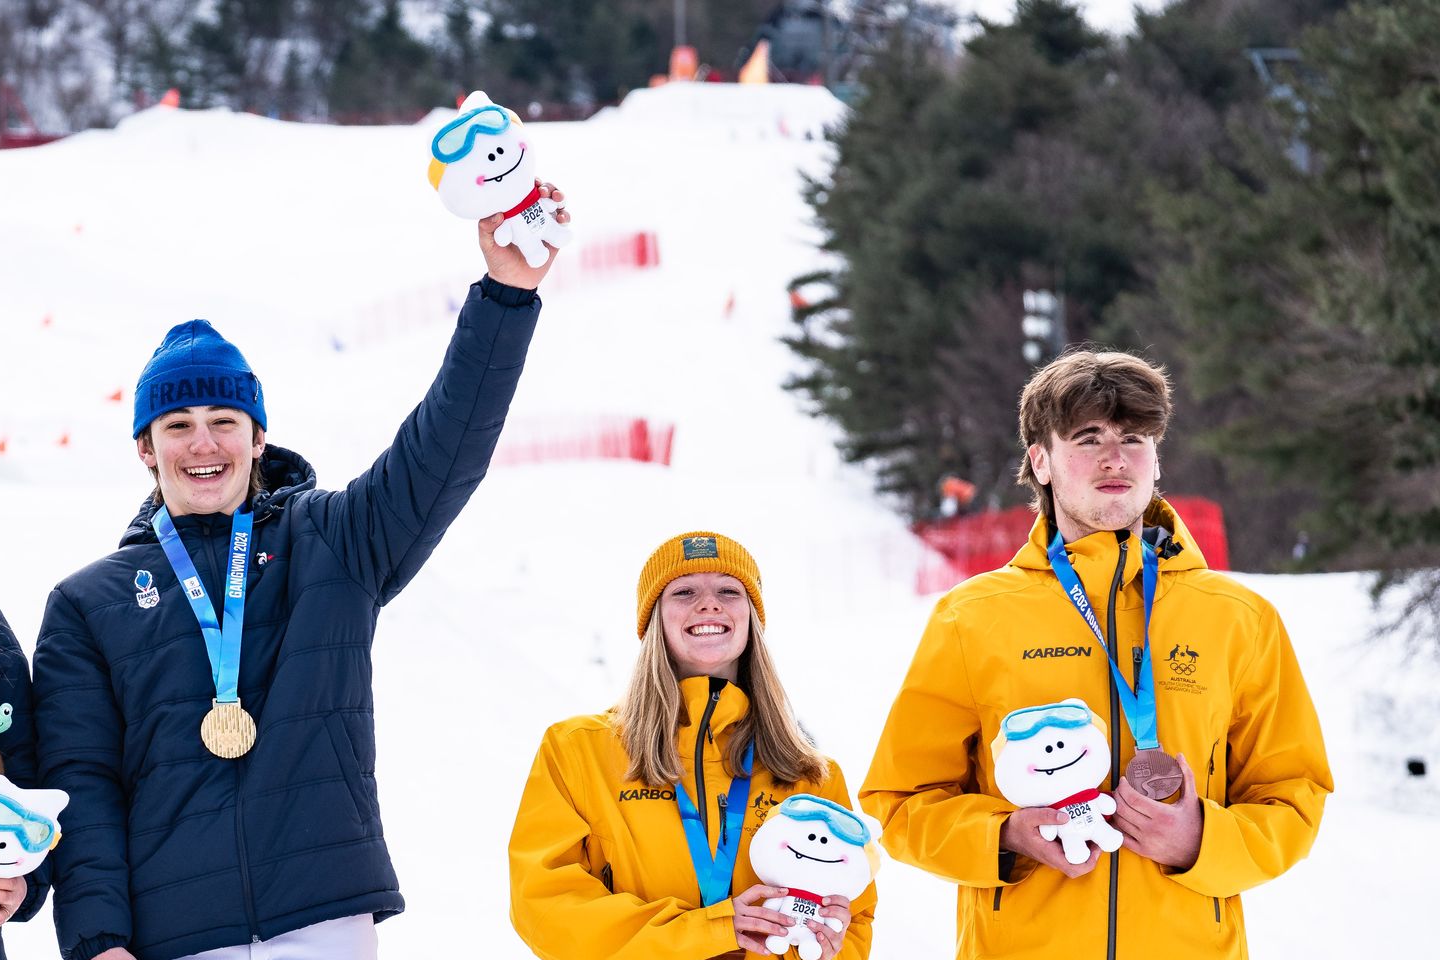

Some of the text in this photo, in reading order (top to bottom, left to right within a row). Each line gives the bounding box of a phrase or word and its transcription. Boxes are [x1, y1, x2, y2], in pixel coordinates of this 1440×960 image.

[524, 206, 543, 224] 2024
[149, 375, 248, 411] FRANCE
[229, 531, 249, 599] GANGWON 2024
[137, 591, 157, 600] FRANCE
[1069, 583, 1088, 612] 2024
[1023, 646, 1092, 660] KARBON
[1069, 803, 1091, 819] 2024
[792, 903, 816, 917] 2024
